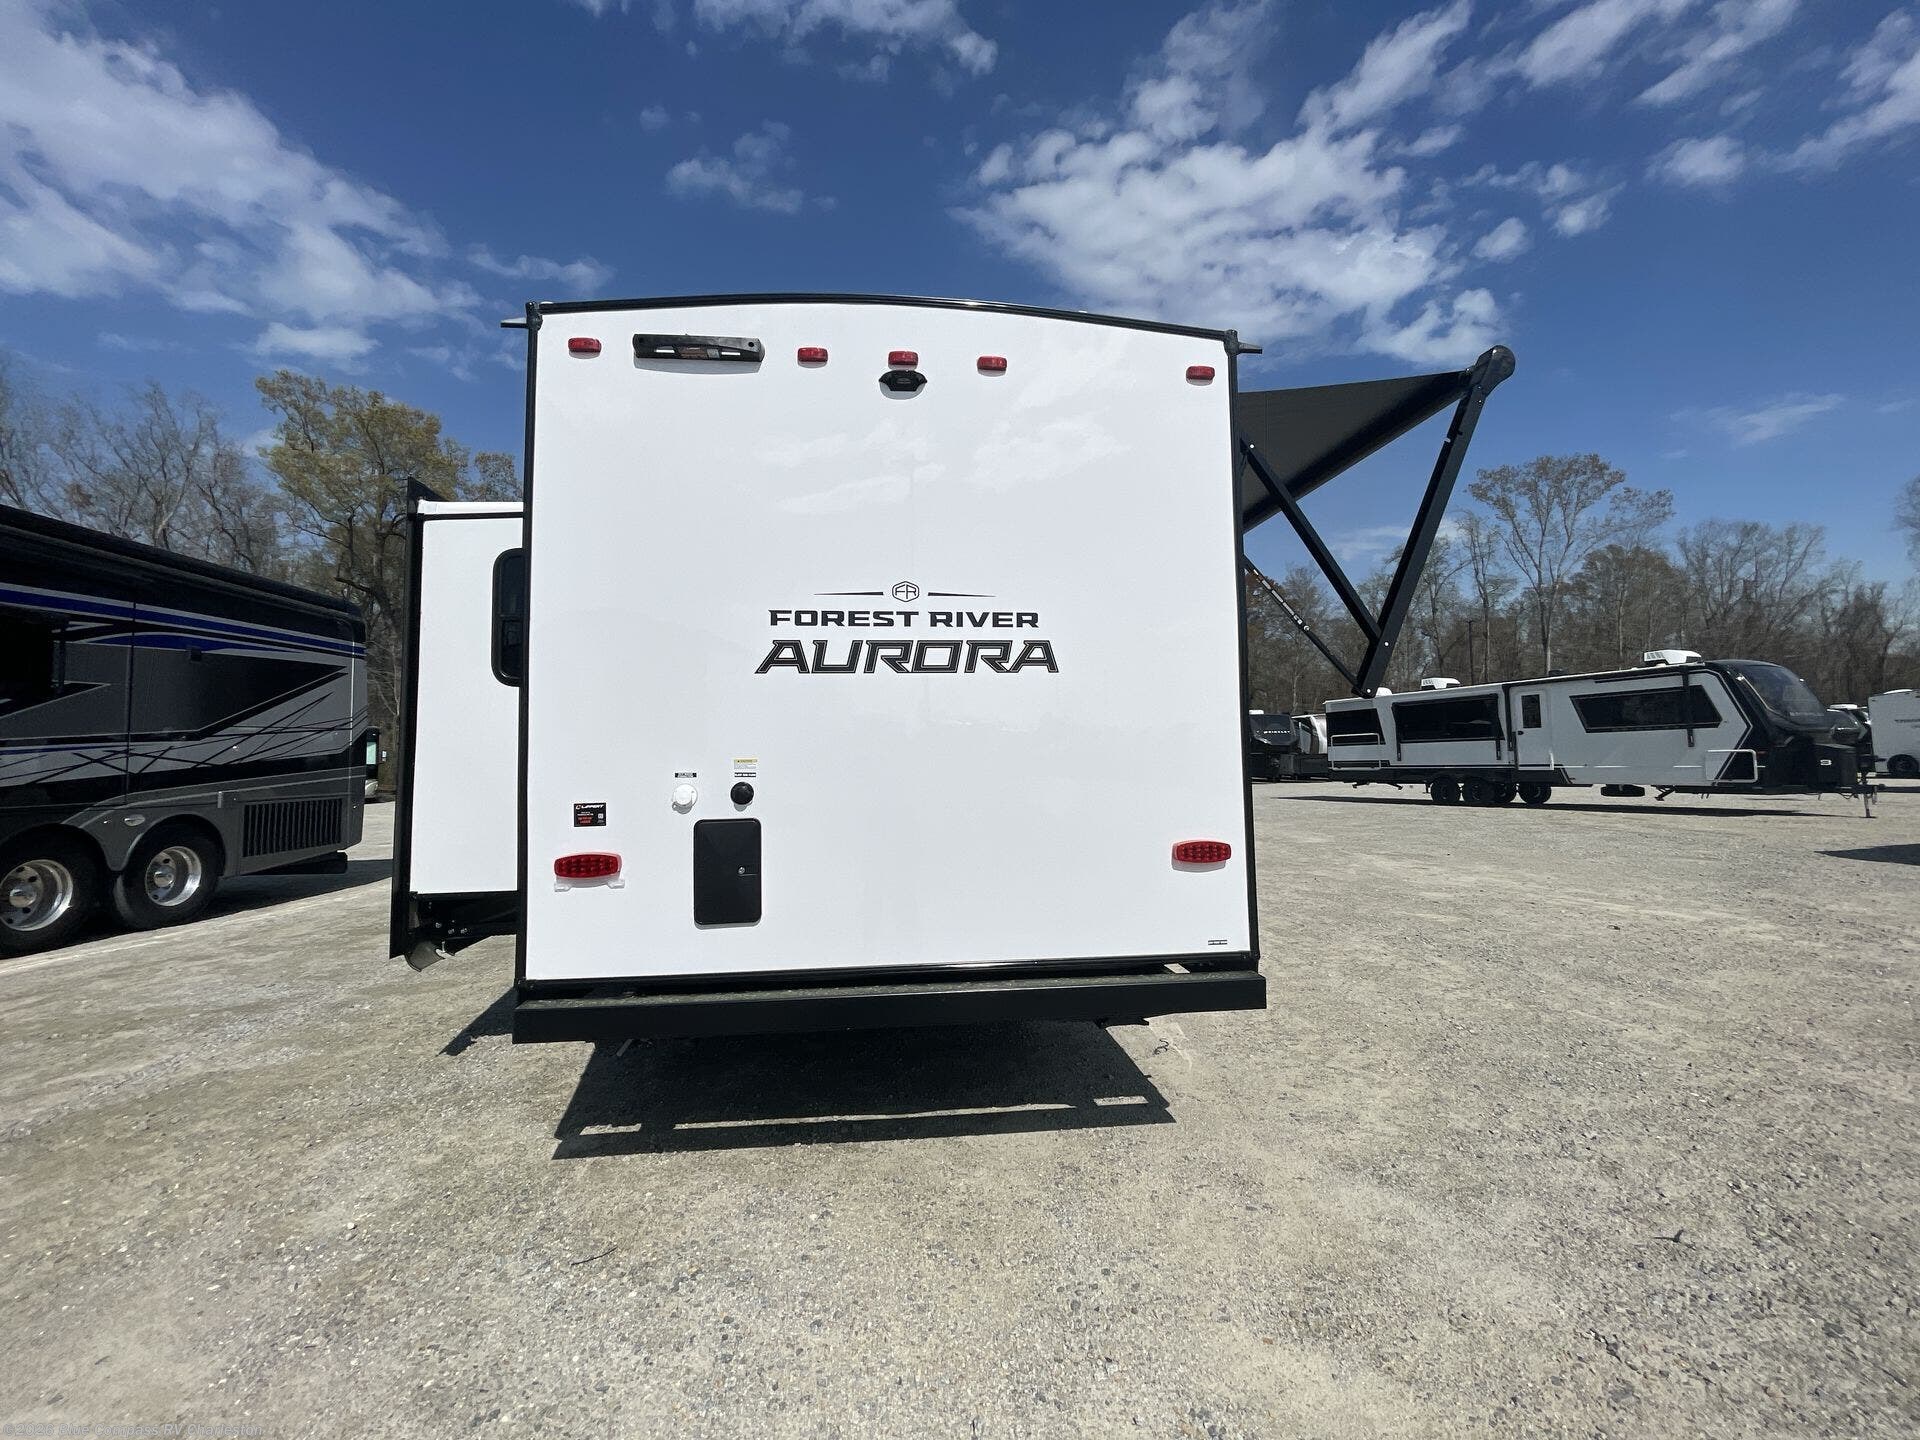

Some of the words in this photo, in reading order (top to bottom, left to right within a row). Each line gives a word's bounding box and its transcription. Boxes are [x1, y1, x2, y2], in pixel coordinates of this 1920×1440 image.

[768, 609, 919, 627] FOREST
[928, 610, 1039, 628] RIVER
[754, 639, 1059, 674] AURORA
